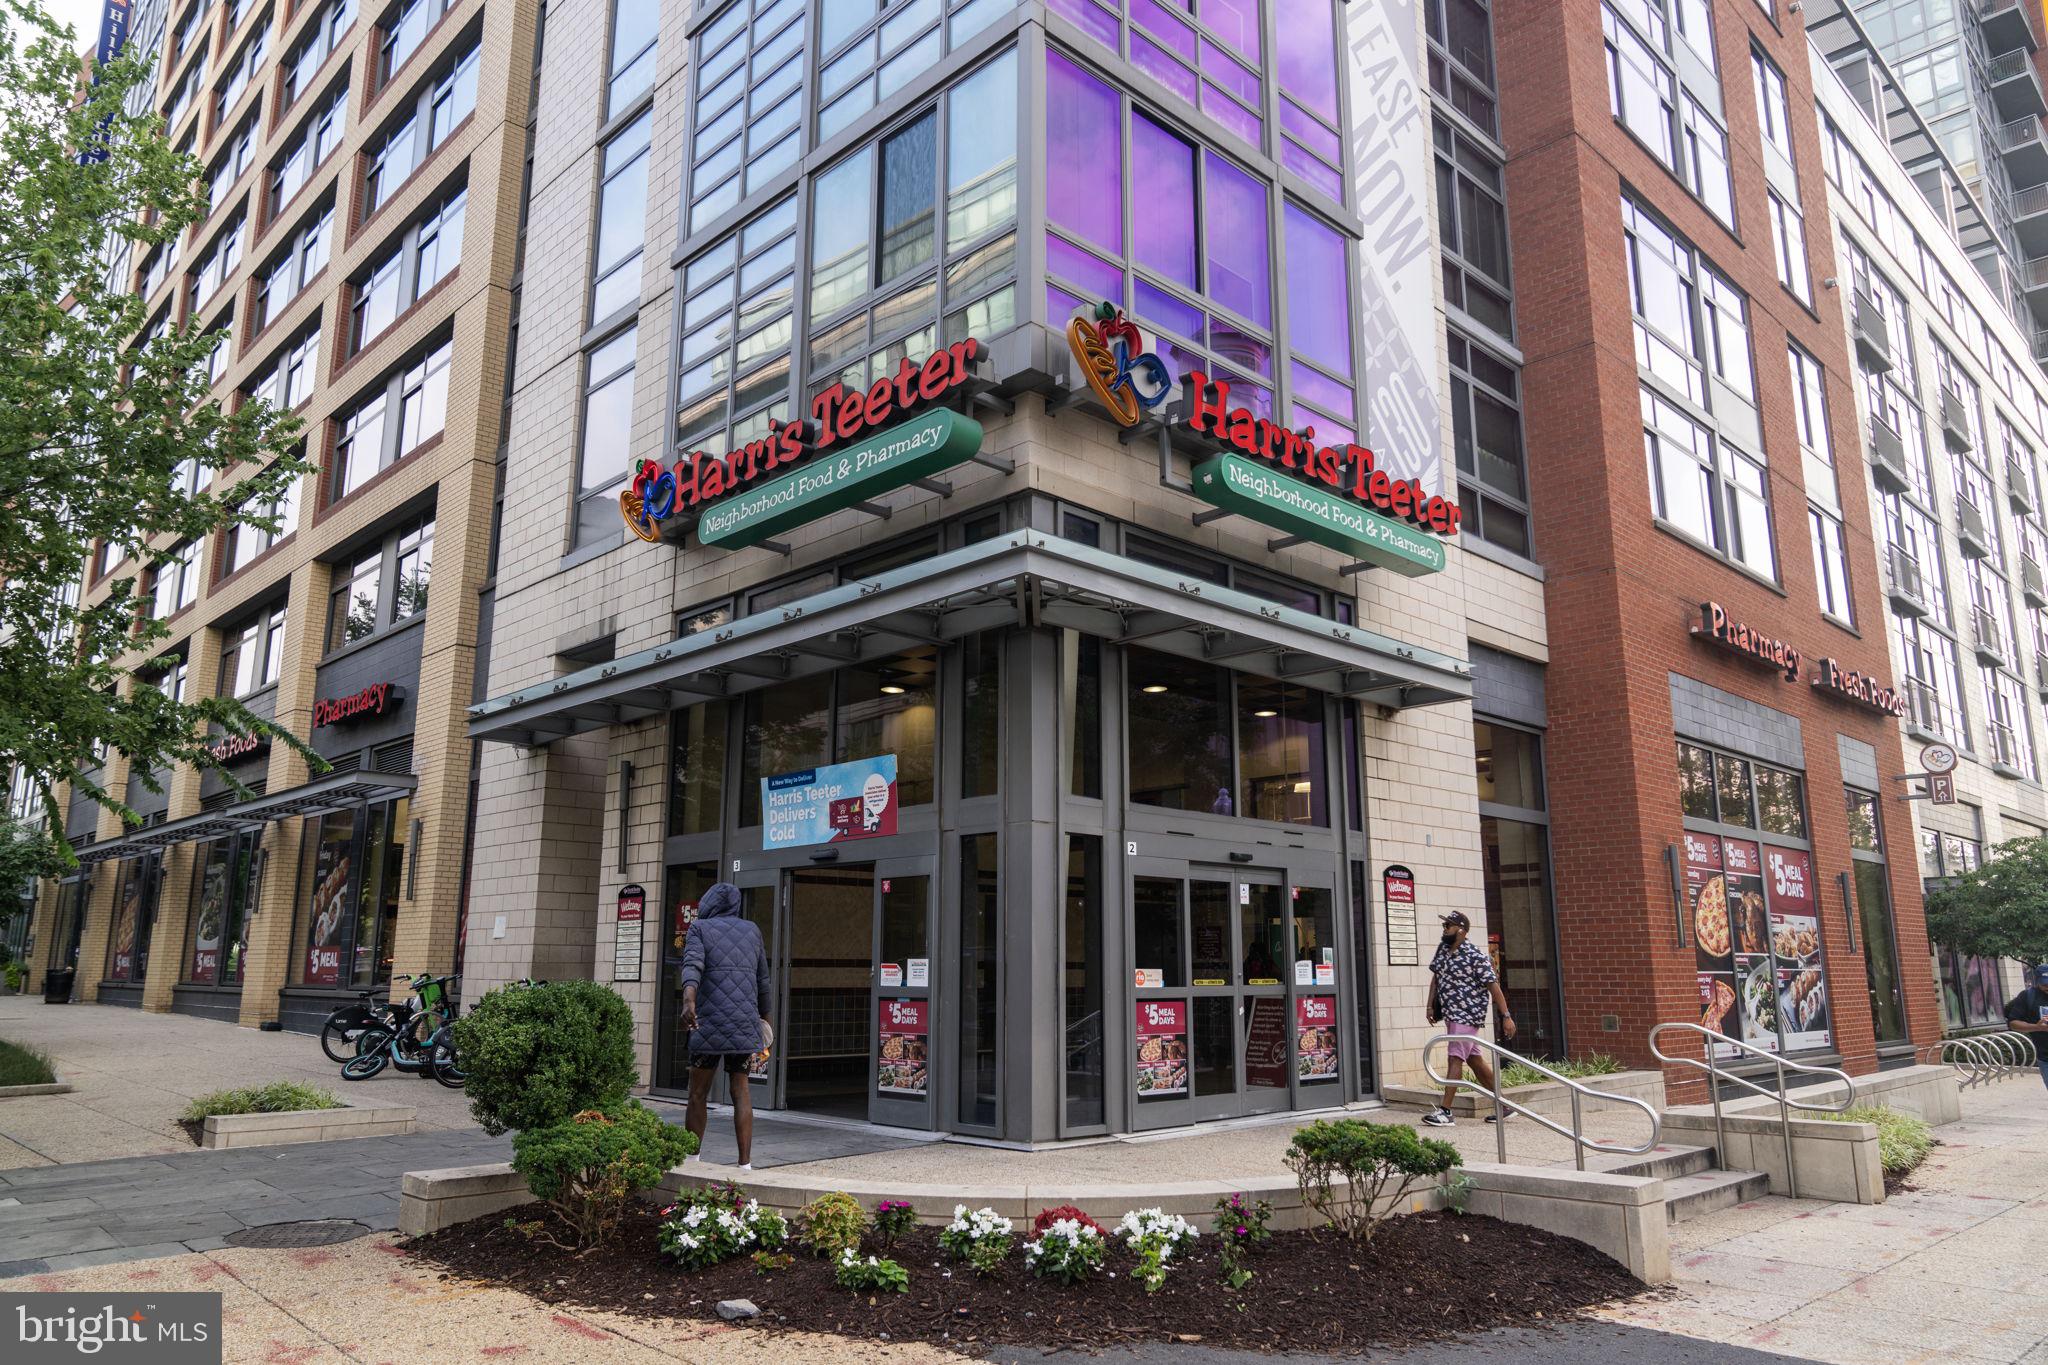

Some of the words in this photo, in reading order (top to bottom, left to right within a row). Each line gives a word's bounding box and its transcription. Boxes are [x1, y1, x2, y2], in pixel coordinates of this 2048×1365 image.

[673, 418, 803, 513] Harris
[812, 337, 978, 450] Teeter
[1189, 370, 1340, 487] Harris
[1347, 444, 1462, 536] Teeter
[705, 483, 795, 536] Neighborhood
[798, 466, 833, 497] Food
[836, 459, 852, 480] &
[856, 424, 944, 473] Pharmacy
[1229, 463, 1329, 519] Neighborhood
[1331, 506, 1363, 533] Food
[1366, 518, 1378, 538] &
[1381, 525, 1440, 565] Pharmacy
[1710, 602, 1802, 683] Pharmacy
[1828, 657, 1868, 702] Fresh
[1868, 677, 1904, 717] Foods
[313, 682, 387, 728] Pharmacy
[229, 729, 257, 757] Foods
[769, 789, 803, 807] Harris
[804, 784, 842, 802] Teeter
[1937, 780, 1946, 791] P
[769, 807, 816, 825] Delivers
[769, 824, 795, 842] Cold
[1769, 852, 1786, 896] $5
[1784, 865, 1803, 881] MEAL
[1388, 880, 1411, 895] Welcome
[1787, 881, 1804, 898] DAYS
[621, 900, 640, 912] Welcome
[681, 905, 691, 924] $5
[311, 949, 319, 974] $5
[320, 953, 338, 967] MEAL
[889, 1003, 901, 1024] $5
[902, 1008, 918, 1016] MEAL
[1145, 1004, 1159, 1025] $5
[1159, 1008, 1175, 1016] MEAL
[1303, 999, 1314, 1018] $5
[1314, 1010, 1327, 1018] DAYS
[902, 1016, 917, 1024] DAYS
[1159, 1016, 1175, 1025] DAYS
